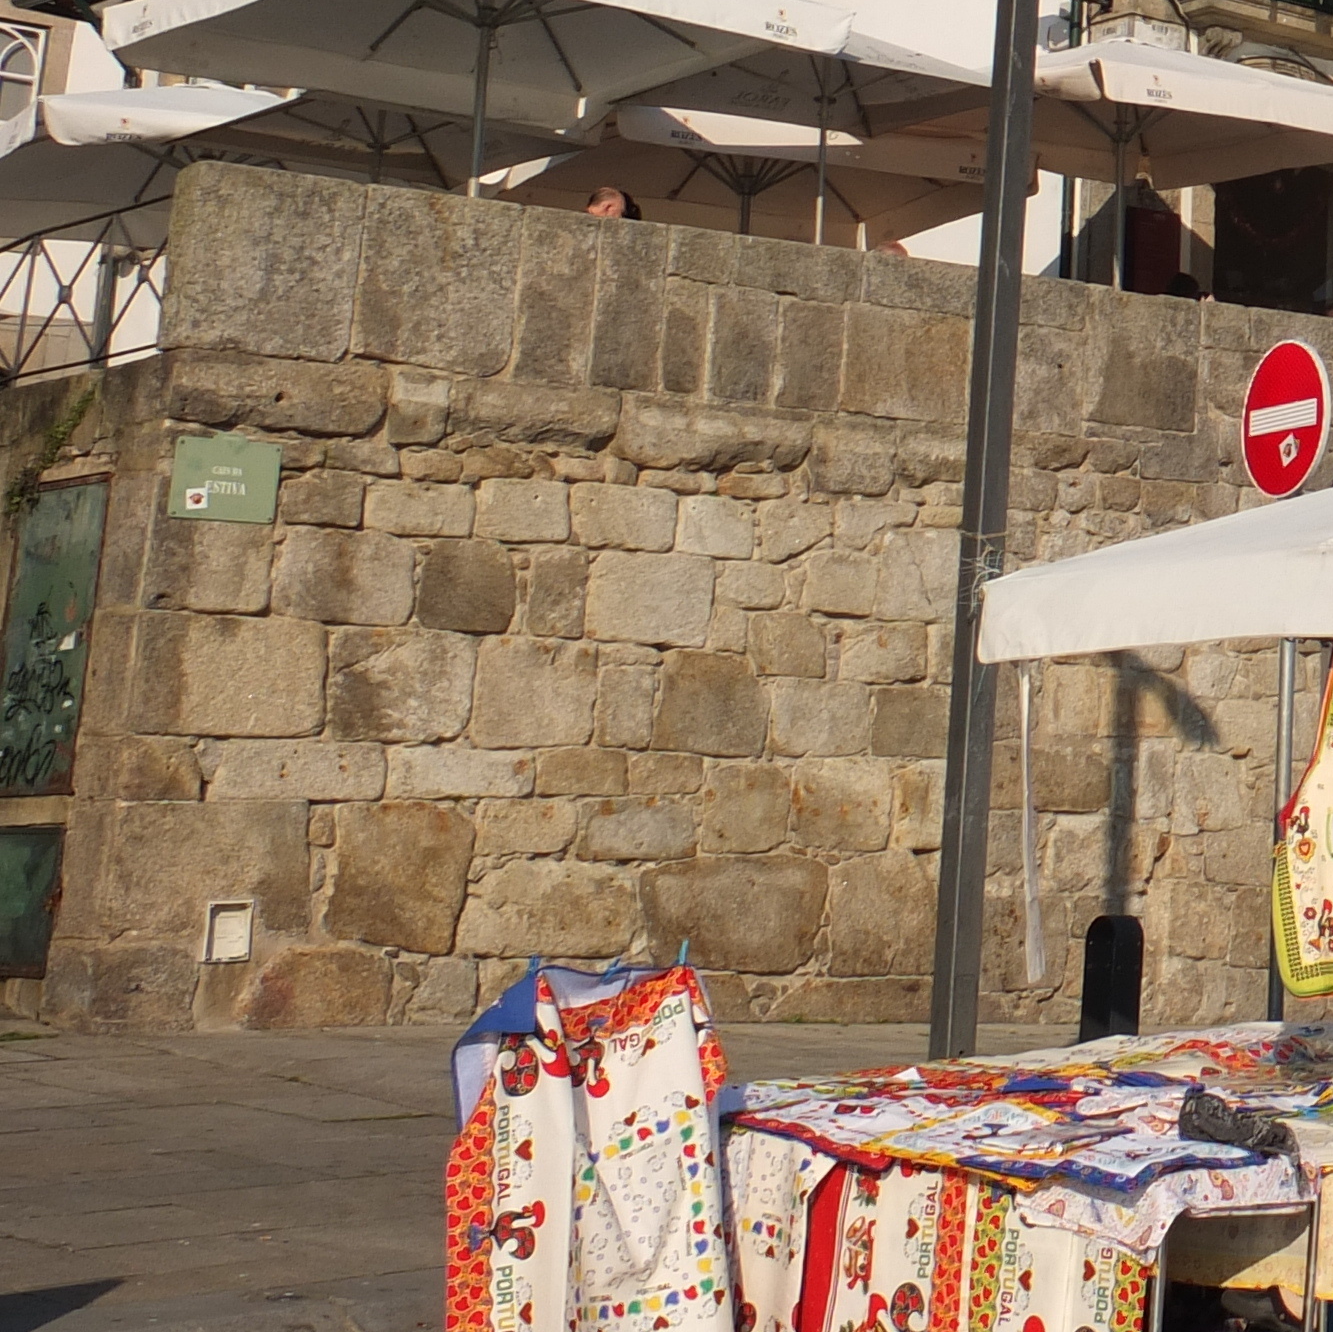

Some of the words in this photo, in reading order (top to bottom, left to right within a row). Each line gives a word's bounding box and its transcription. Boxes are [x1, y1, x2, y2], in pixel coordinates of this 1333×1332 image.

[205, 479, 246, 496] ESTIVA
[497, 1104, 511, 1207] PORTUGAL
[916, 1179, 939, 1280] PORTUGAL
[997, 1228, 1021, 1326] PORTUGAL
